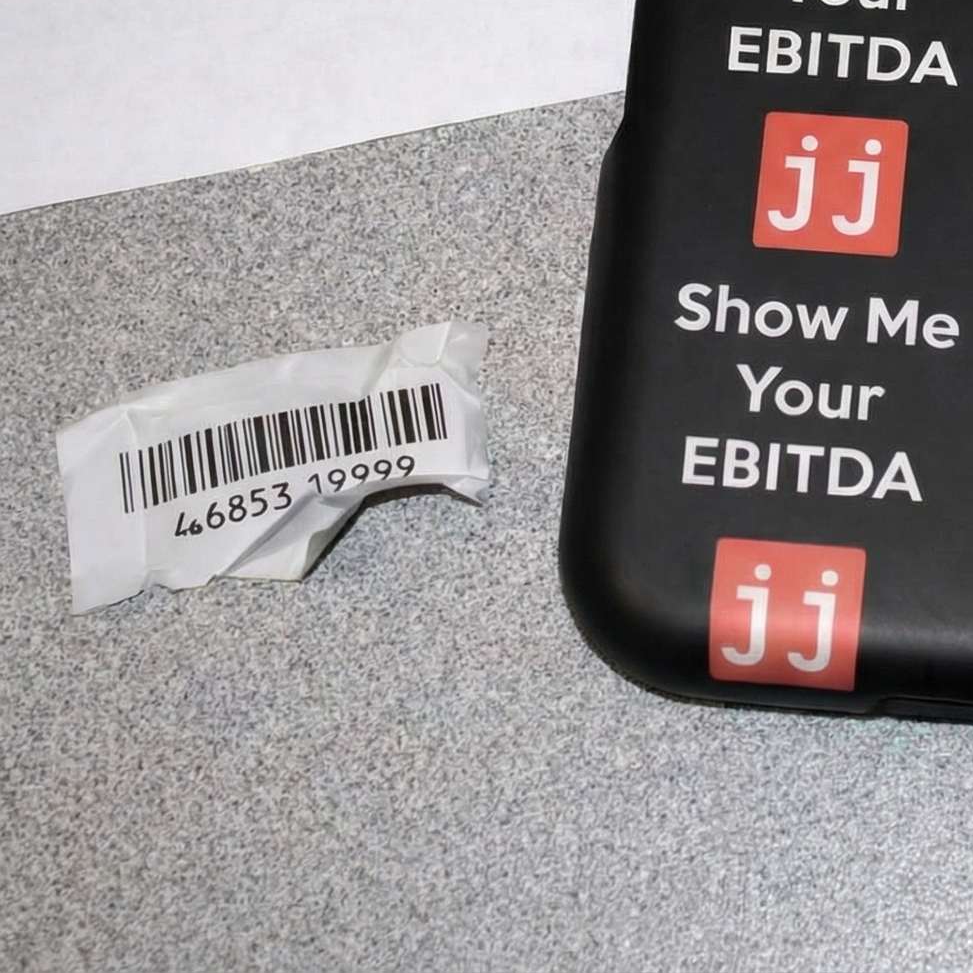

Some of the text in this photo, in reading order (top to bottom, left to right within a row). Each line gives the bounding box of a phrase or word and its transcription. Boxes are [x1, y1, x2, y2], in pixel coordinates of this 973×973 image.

[727, 25, 958, 87] EBITDA
[673, 282, 960, 350] Show Me
[736, 363, 886, 421] Your
[307, 455, 416, 494] 19999
[681, 435, 923, 502] EBITDA
